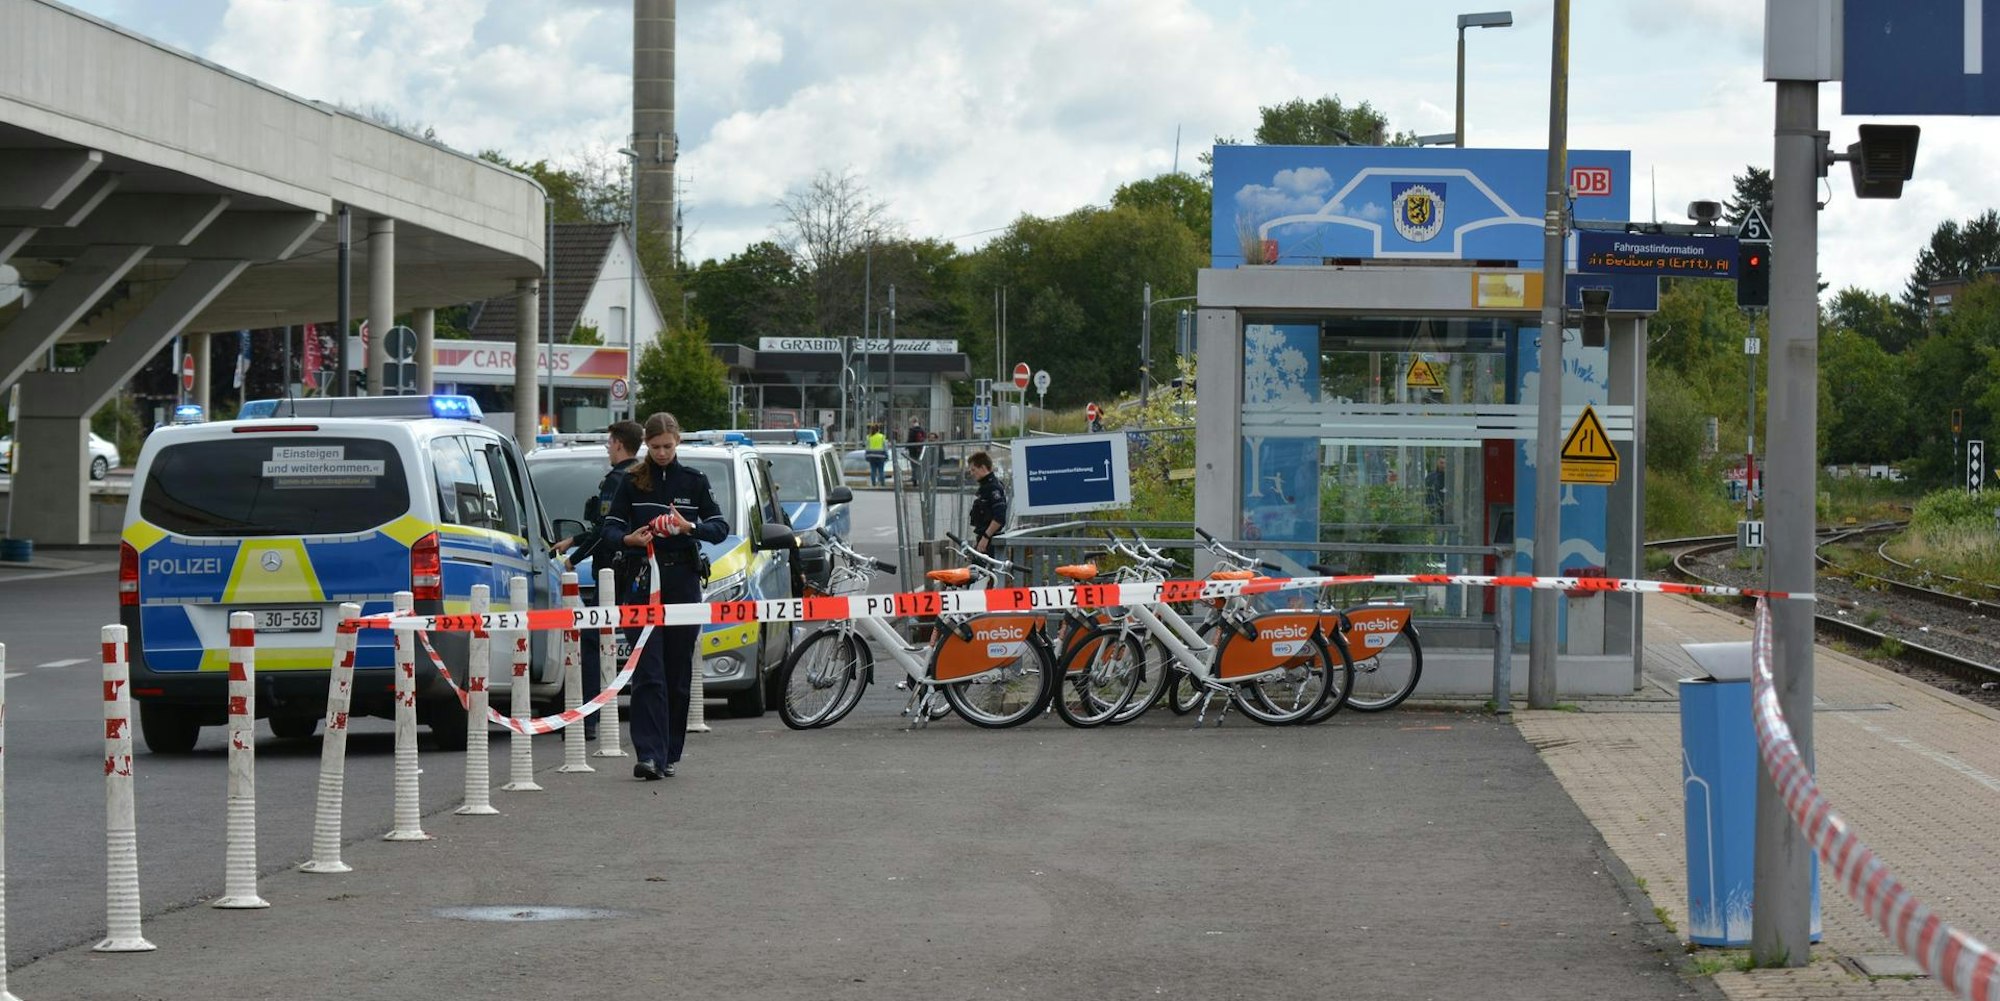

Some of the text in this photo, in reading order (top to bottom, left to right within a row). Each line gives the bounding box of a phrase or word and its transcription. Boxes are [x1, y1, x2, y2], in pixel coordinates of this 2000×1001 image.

[1576, 172, 1606, 191] DB
[1748, 218, 1760, 239] 5
[1613, 242, 1704, 256] Fahrgastinformation
[781, 339, 862, 351] GRABME
[473, 350, 570, 370] CARASS
[615, 384, 624, 394] 30
[267, 463, 288, 474] und
[1748, 523, 1762, 545] H
[147, 558, 222, 575] POLIZEI
[867, 594, 961, 615] POLIZEI
[1013, 589, 1105, 608] POLIZEI
[573, 608, 666, 626] POLIZEI
[720, 600, 814, 621] POLIZEI
